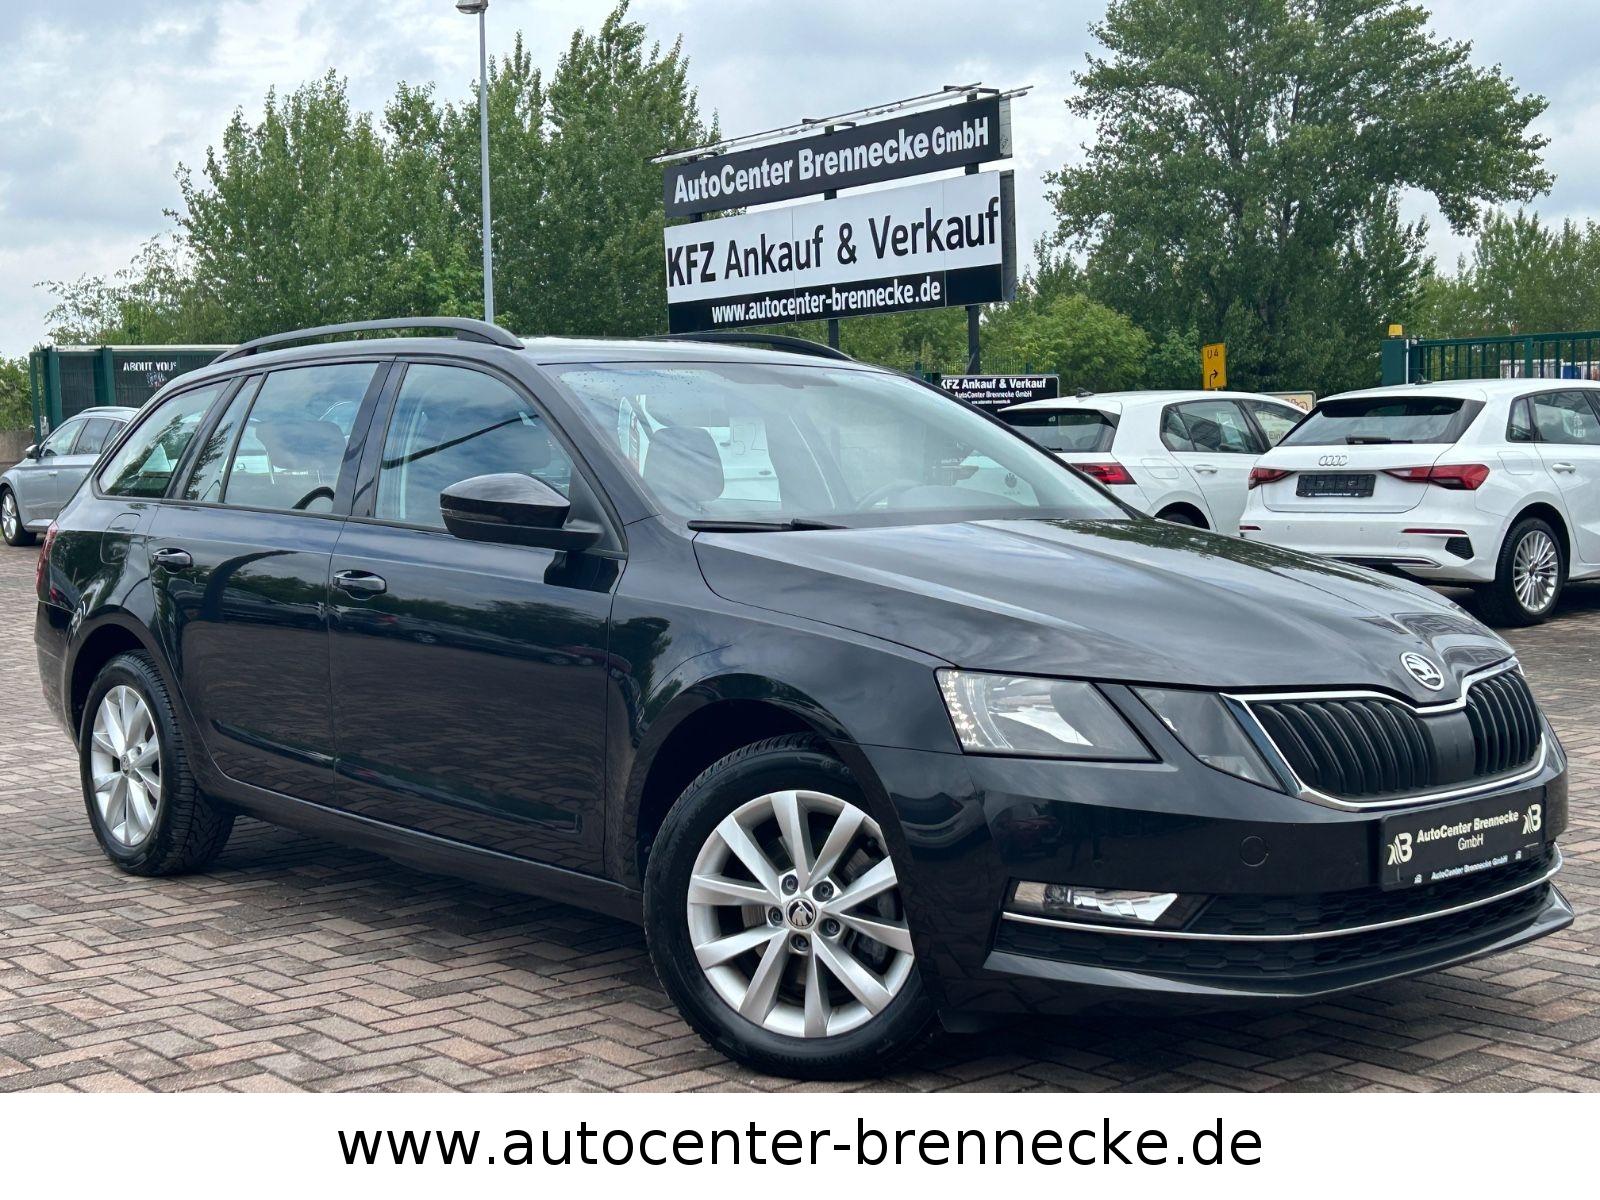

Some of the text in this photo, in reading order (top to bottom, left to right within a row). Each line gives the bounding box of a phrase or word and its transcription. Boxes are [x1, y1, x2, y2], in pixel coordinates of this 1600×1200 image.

[674, 116, 989, 204] AutoCenter Brennecke GmbH
[667, 196, 999, 287] KFZ Ankauf & Verkauf
[711, 275, 941, 324] www.autocenter-brennecke.de
[123, 361, 152, 371] ABOUT
[962, 378, 996, 389] Ankauf
[999, 378, 1007, 388] &
[1009, 378, 1046, 388] Verkauf
[1417, 810, 1519, 843] AutoCenter Brennecke
[1458, 833, 1484, 851] GmbH
[1431, 855, 1508, 880] AutoCenter Brennecke GmbH
